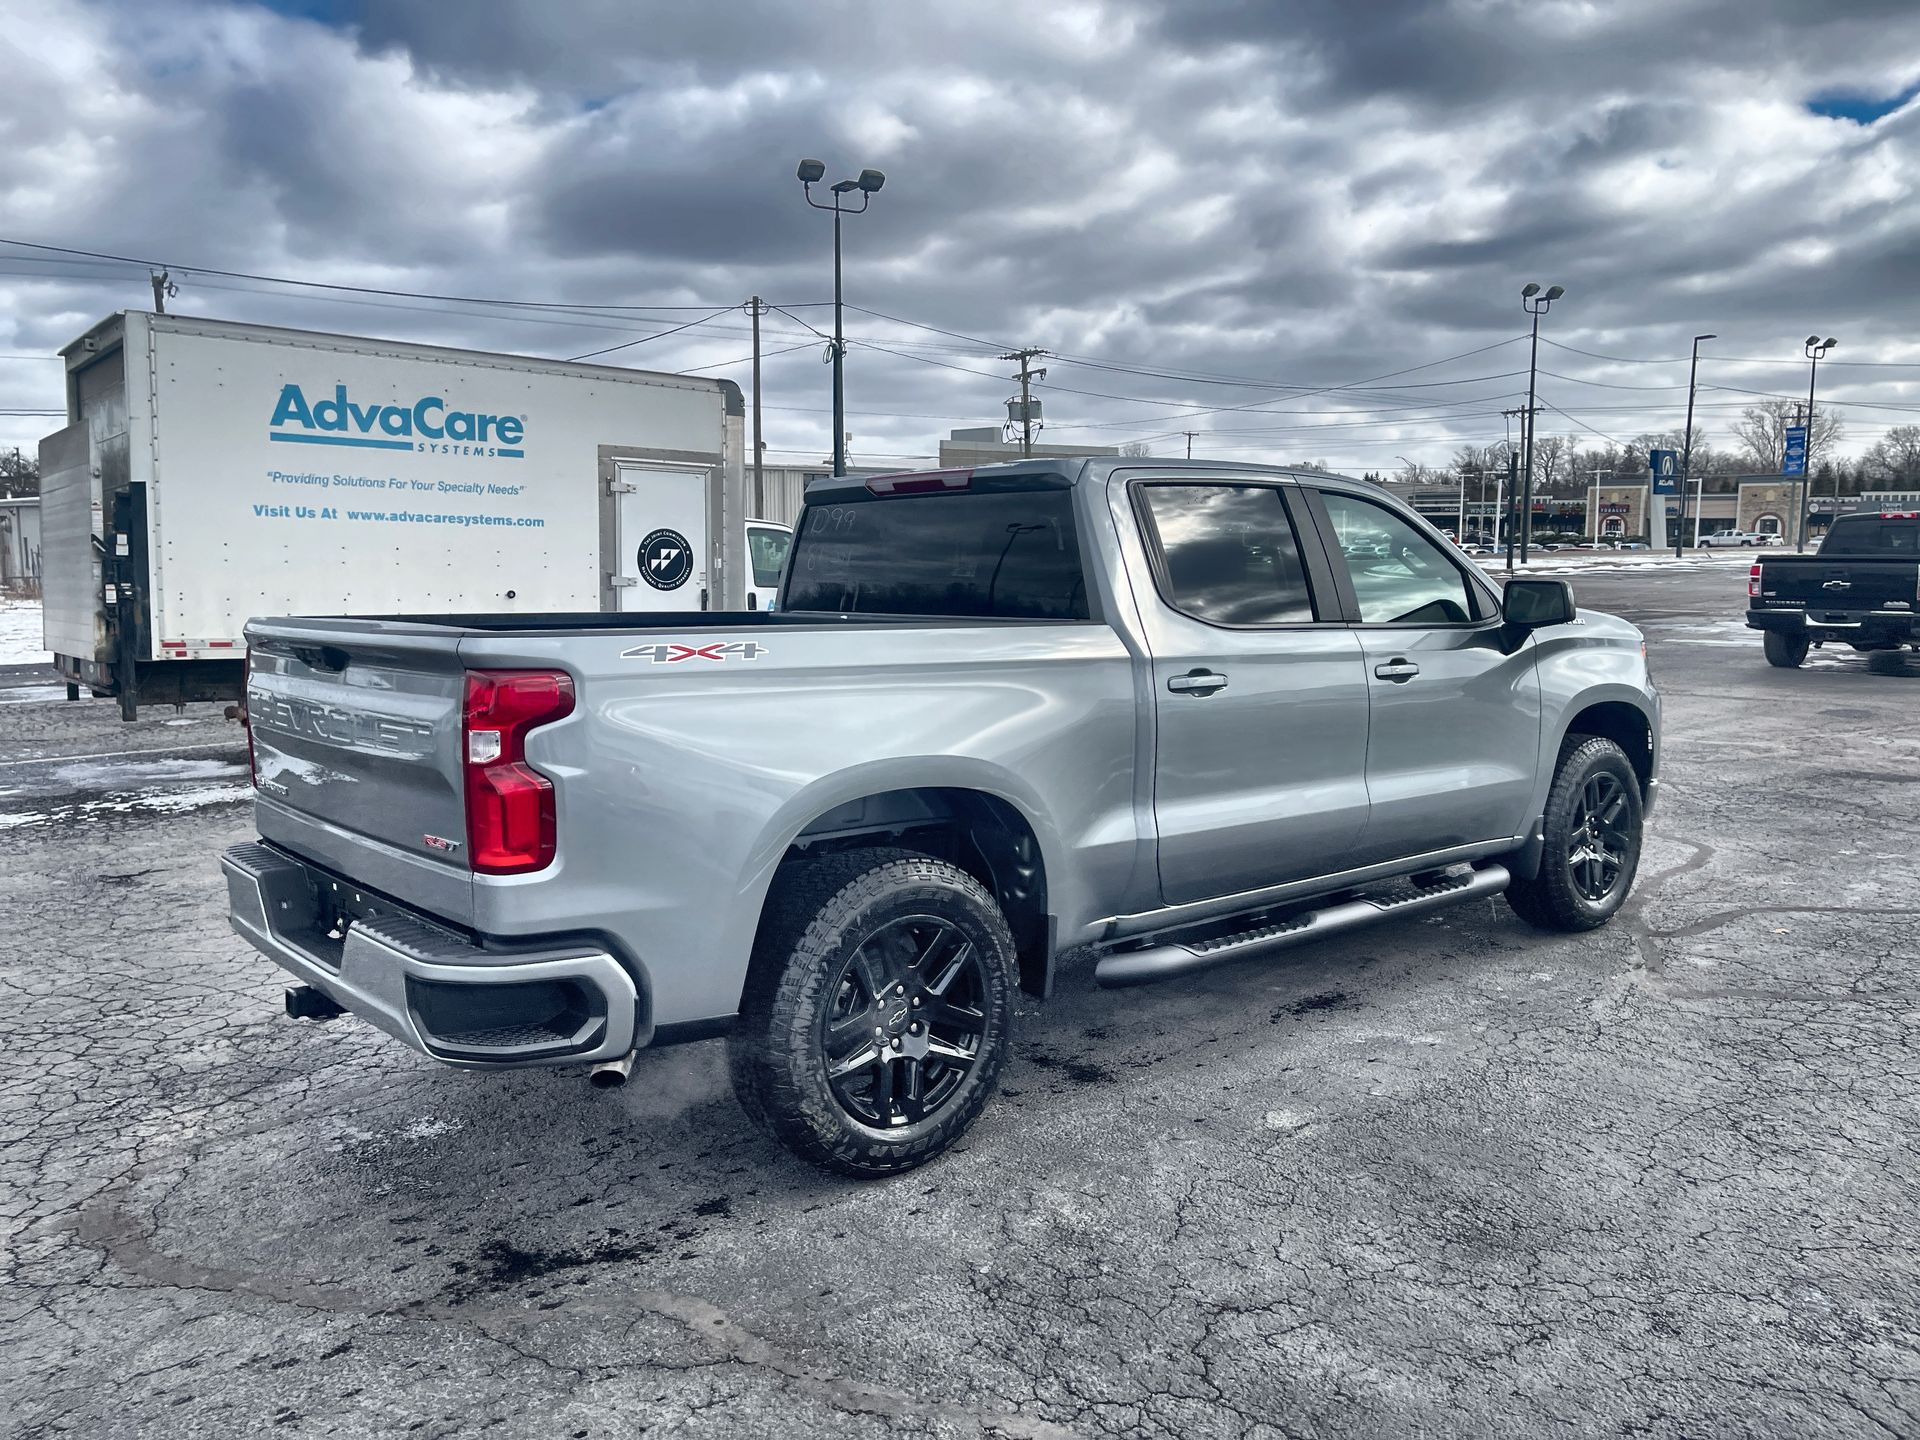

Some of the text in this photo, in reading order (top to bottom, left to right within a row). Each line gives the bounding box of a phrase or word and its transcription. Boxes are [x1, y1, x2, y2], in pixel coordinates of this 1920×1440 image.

[417, 442, 496, 458] SYSTEMS
[332, 474, 386, 489] Solutions
[388, 478, 408, 489] For
[410, 479, 435, 492] Your
[437, 480, 485, 496] Specialty
[253, 504, 545, 528] Visit Us At www.advacaresystems.com
